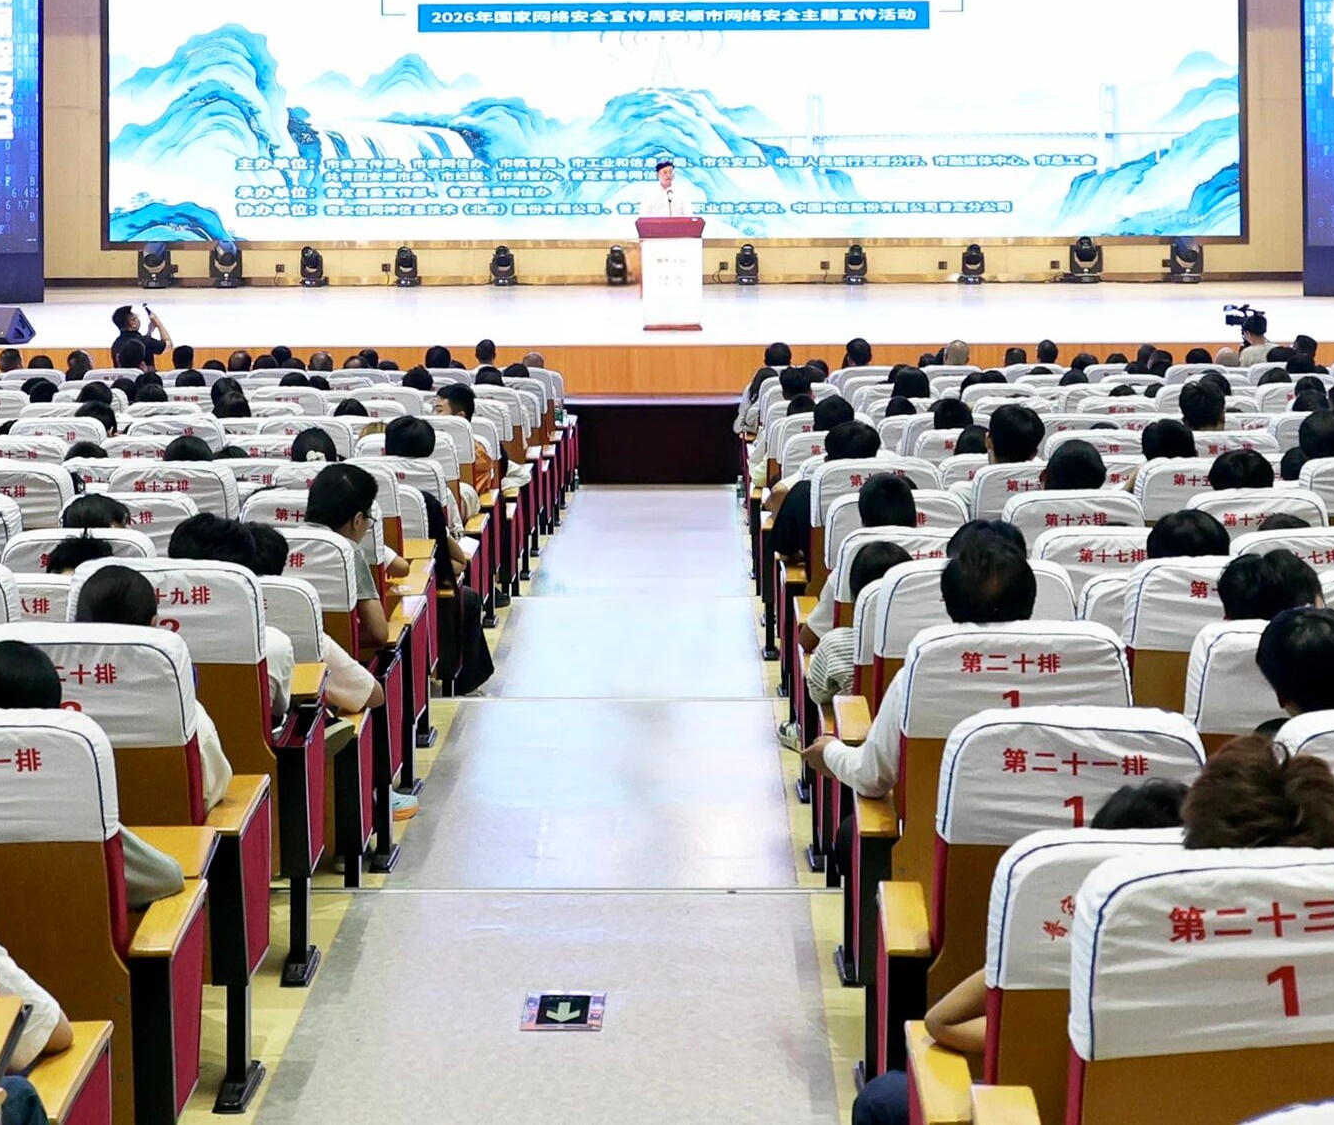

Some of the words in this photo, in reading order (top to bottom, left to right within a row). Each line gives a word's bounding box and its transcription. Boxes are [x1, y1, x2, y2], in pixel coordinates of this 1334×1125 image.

[431, 7, 917, 27] 2026年国家网络安全宣传周安顺市网络安全主题宣传活动
[133, 478, 191, 493] 第十五排
[1006, 476, 1045, 492] 第十
[1173, 474, 1210, 486] 第十五
[1, 483, 27, 498] 五排
[275, 508, 303, 522] 第十
[1044, 512, 1108, 527] 第十六排
[1223, 512, 1267, 528] 第十六
[1079, 548, 1147, 563] 第十七排
[155, 585, 211, 606] 十九排
[961, 651, 1062, 674] 第二十排
[59, 664, 117, 684] 二十排
[1003, 748, 1148, 776] 第二十一排
[1064, 796, 1084, 828] 1
[1266, 964, 1301, 1018] 1
